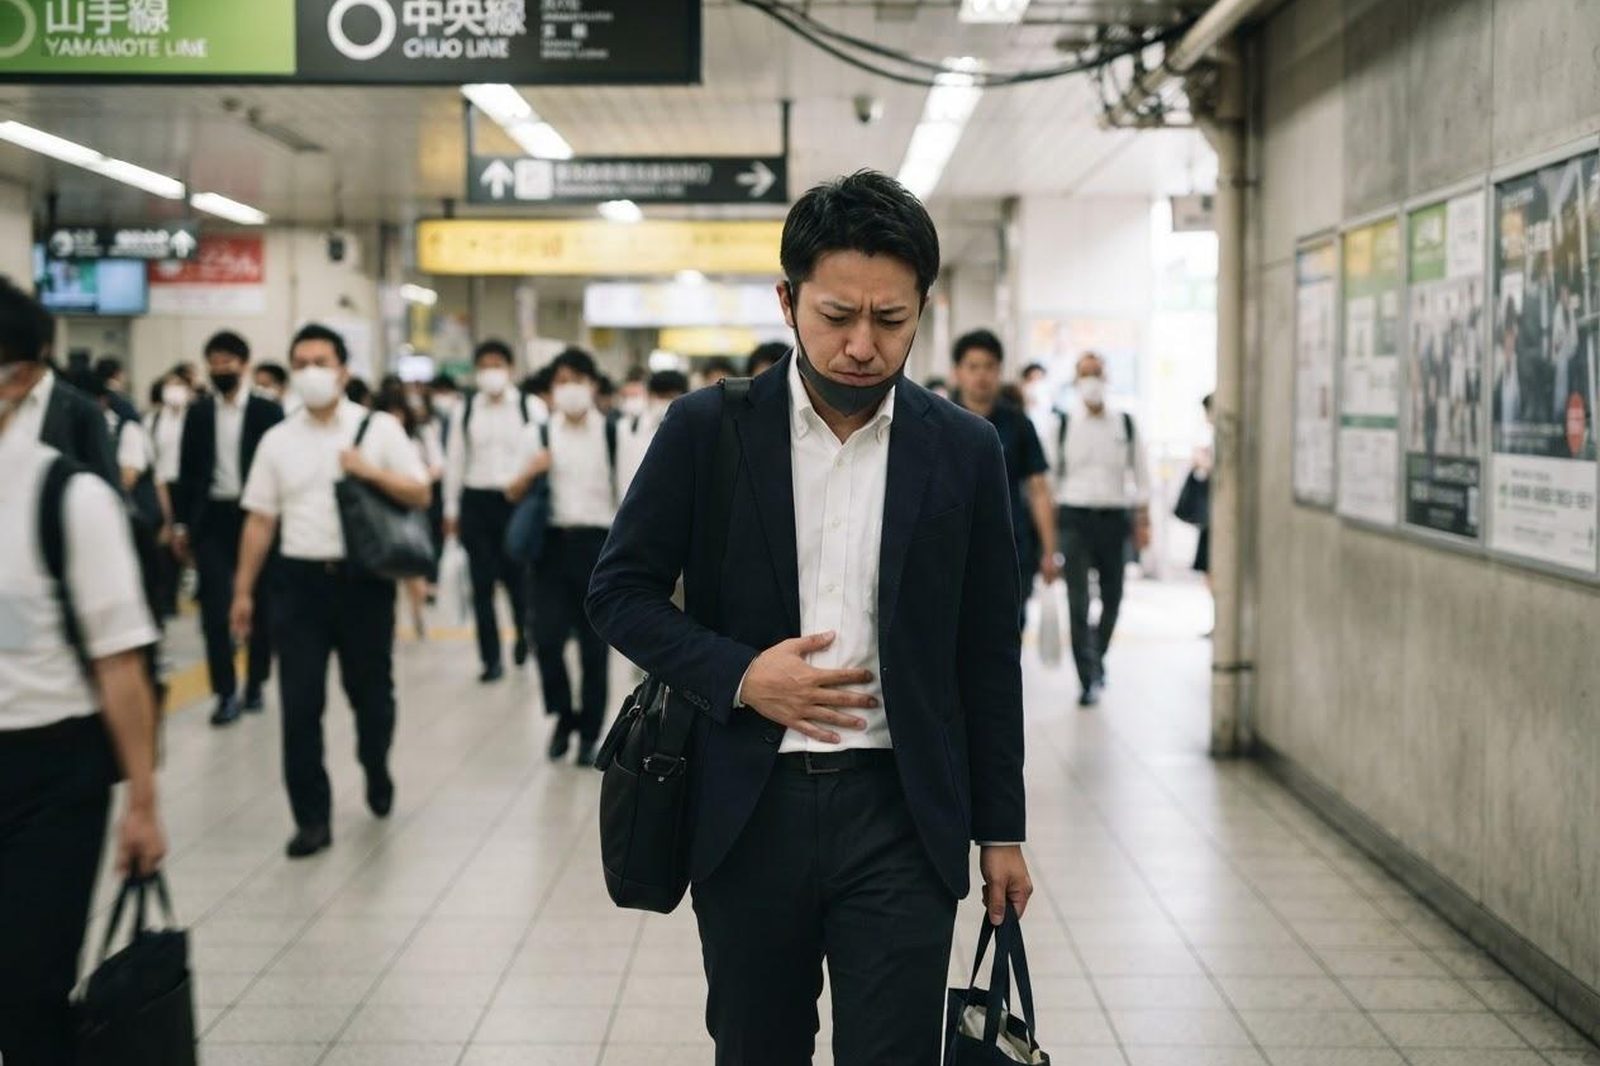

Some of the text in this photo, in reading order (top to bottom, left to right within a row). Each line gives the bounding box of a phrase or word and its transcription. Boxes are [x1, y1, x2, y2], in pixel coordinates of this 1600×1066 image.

[46, 0, 169, 34] 山手線
[403, 0, 527, 36] 中央線
[46, 37, 208, 58] YAMANOTE LINE
[403, 38, 510, 58] CHUO LINE
